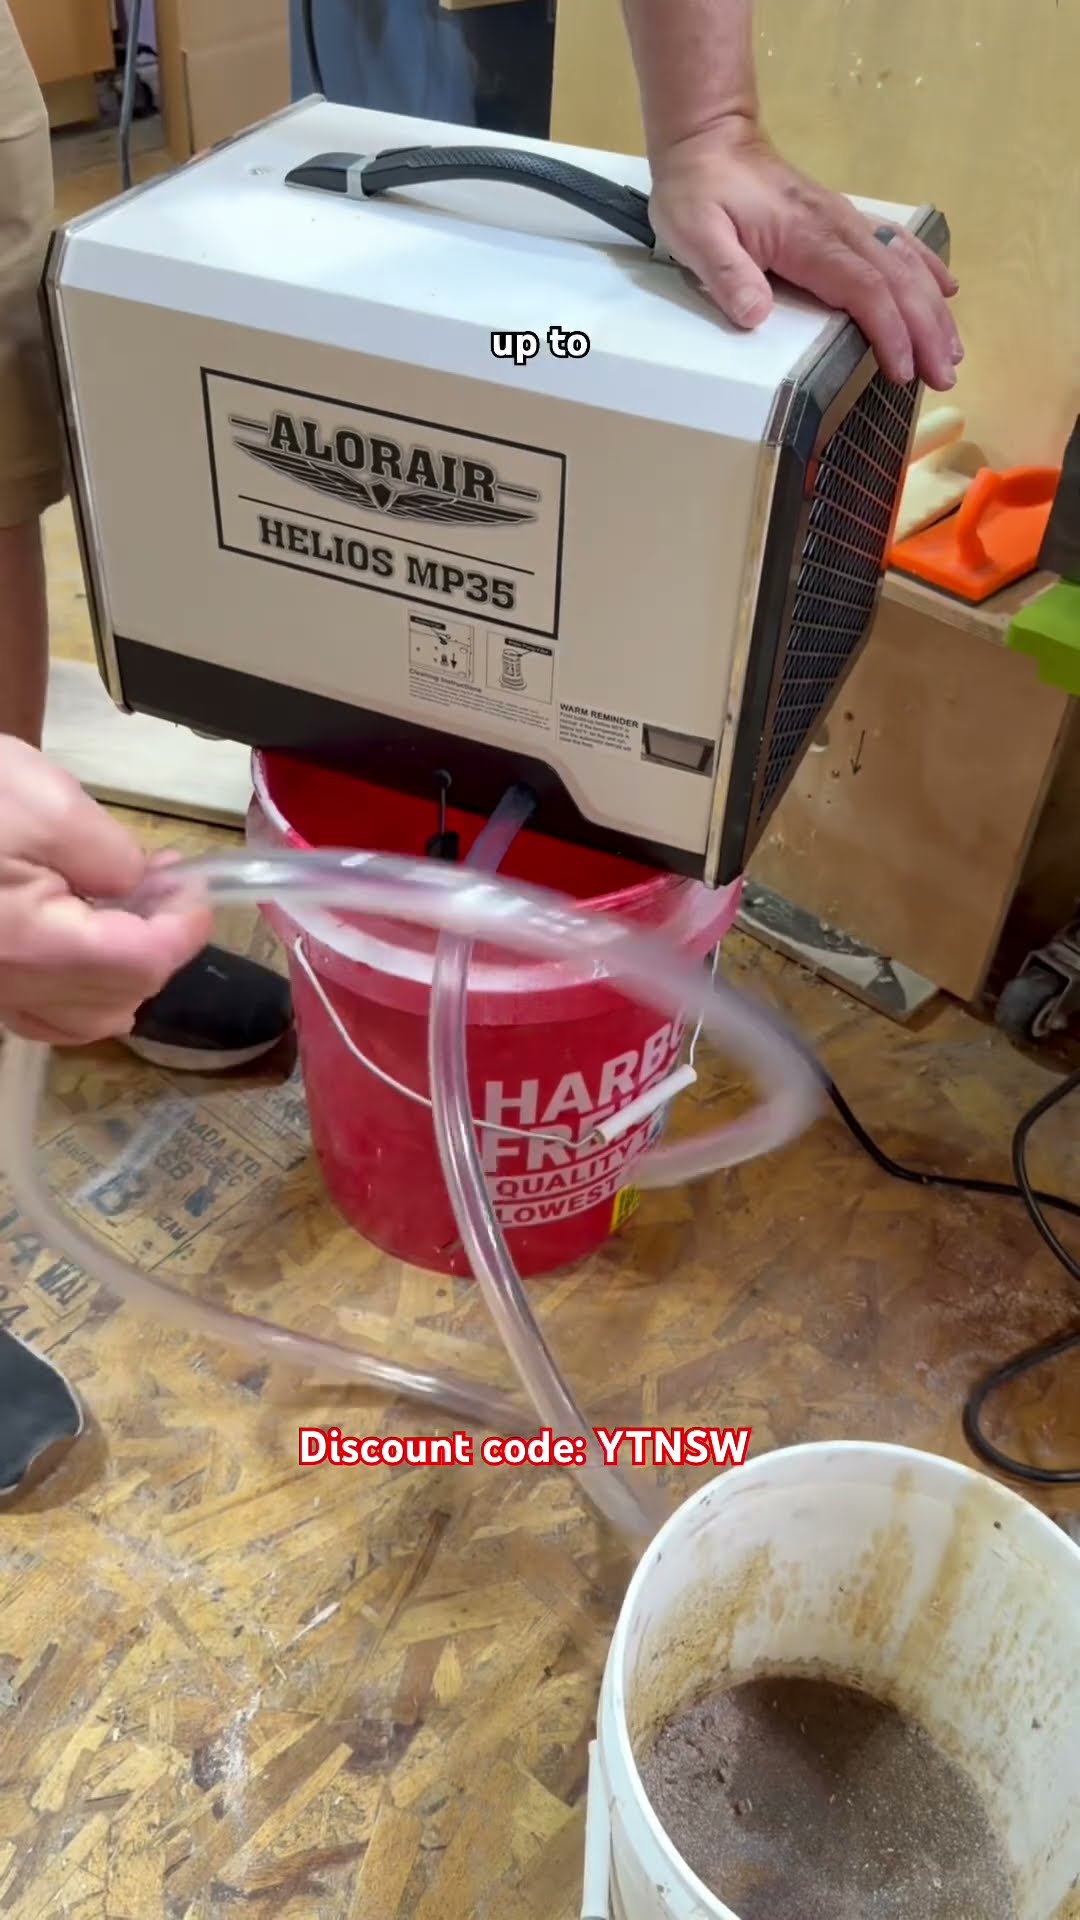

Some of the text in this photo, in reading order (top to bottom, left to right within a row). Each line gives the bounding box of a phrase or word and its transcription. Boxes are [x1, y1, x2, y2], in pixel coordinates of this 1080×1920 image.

[270, 414, 495, 503] ALORAIR
[258, 515, 516, 610] HELIOS MP35
[409, 668, 439, 682] Cleaning
[560, 703, 639, 728] WARM REMINDER
[496, 1139, 635, 1198] QUALITY
[496, 1176, 617, 1224] LOWEST
